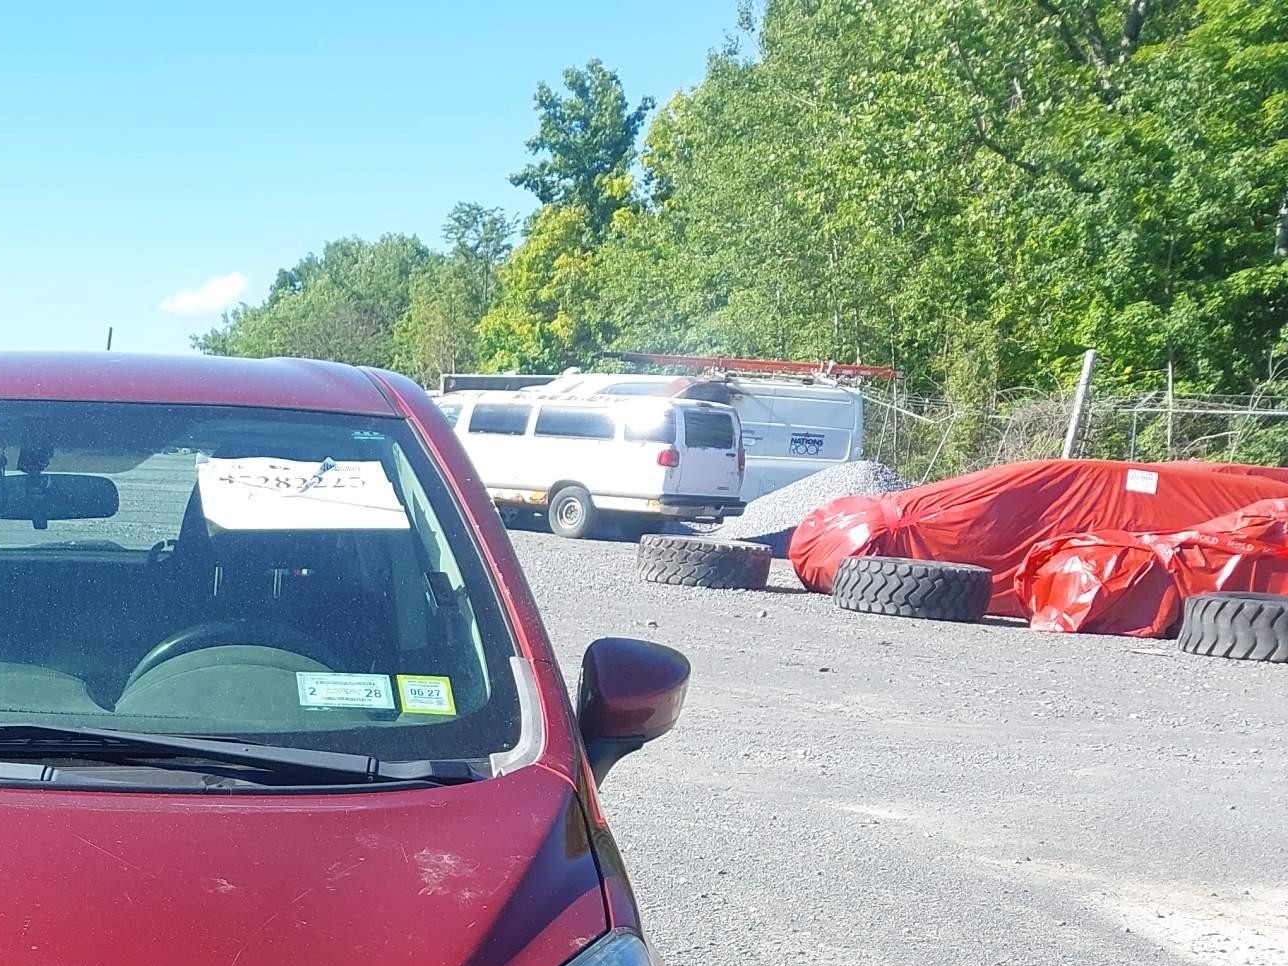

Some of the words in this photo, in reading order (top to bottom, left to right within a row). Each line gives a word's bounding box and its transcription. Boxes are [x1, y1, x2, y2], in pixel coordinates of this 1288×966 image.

[790, 437, 824, 446] NATIONS
[788, 443, 823, 456] ROOF
[308, 686, 318, 696] 2
[364, 688, 383, 699] 28
[427, 689, 441, 698] 27
